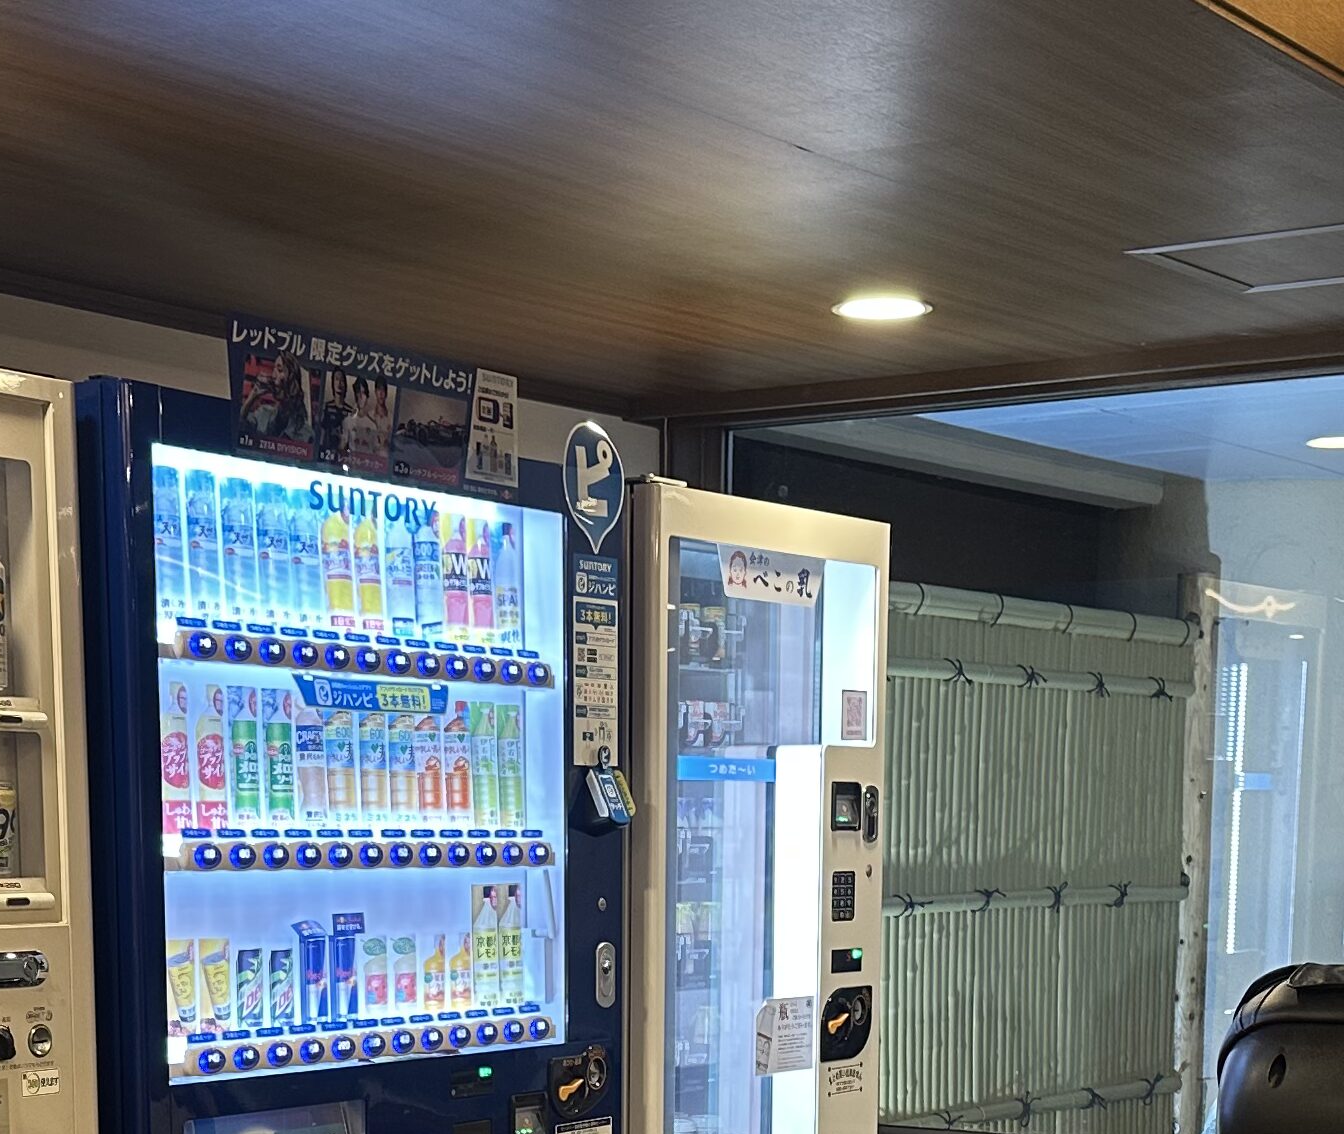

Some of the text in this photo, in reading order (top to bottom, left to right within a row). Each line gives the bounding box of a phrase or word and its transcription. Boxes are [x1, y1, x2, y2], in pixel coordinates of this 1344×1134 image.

[232, 320, 305, 357] レッドブル
[753, 568, 812, 598] べこの乳
